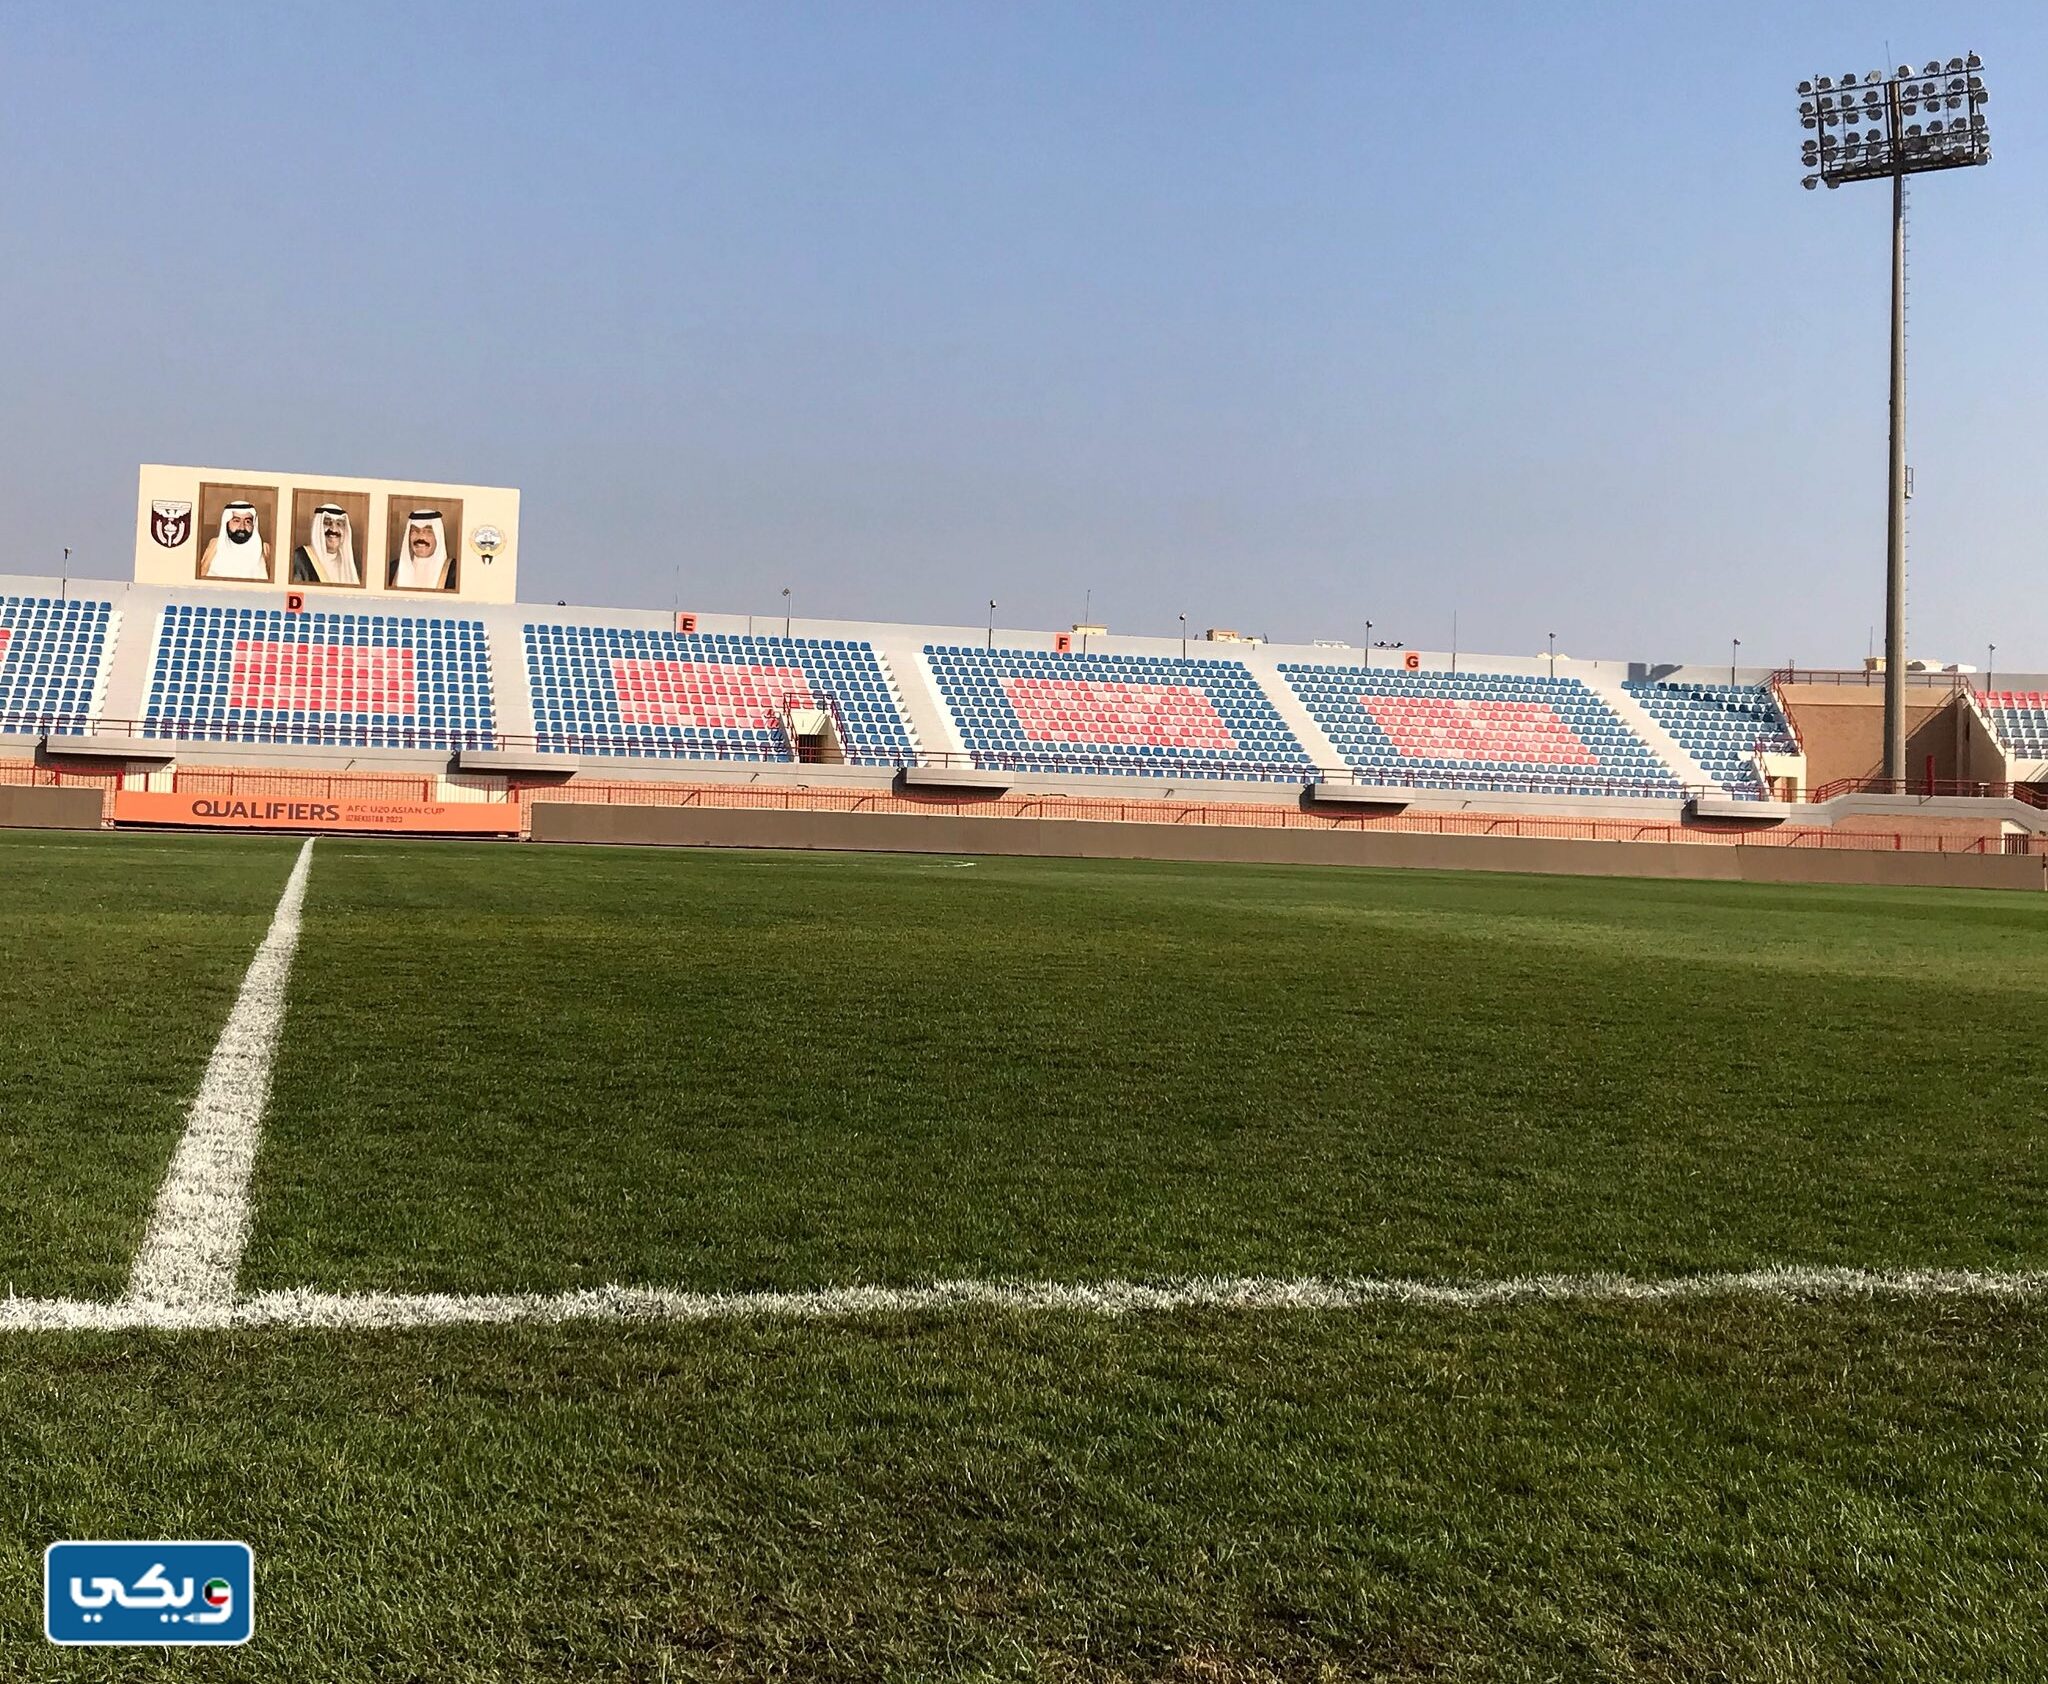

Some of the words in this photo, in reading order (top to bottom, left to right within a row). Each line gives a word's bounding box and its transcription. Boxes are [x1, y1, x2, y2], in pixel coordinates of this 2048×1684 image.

[288, 595, 302, 610] D
[682, 617, 694, 632] E
[1058, 637, 1069, 650] F
[1406, 655, 1419, 668] G
[191, 799, 340, 821] QUALIFIERS
[346, 805, 369, 813] AFC
[370, 806, 390, 814] U20
[391, 806, 422, 814] ASIAN
[423, 807, 446, 815] CUP
